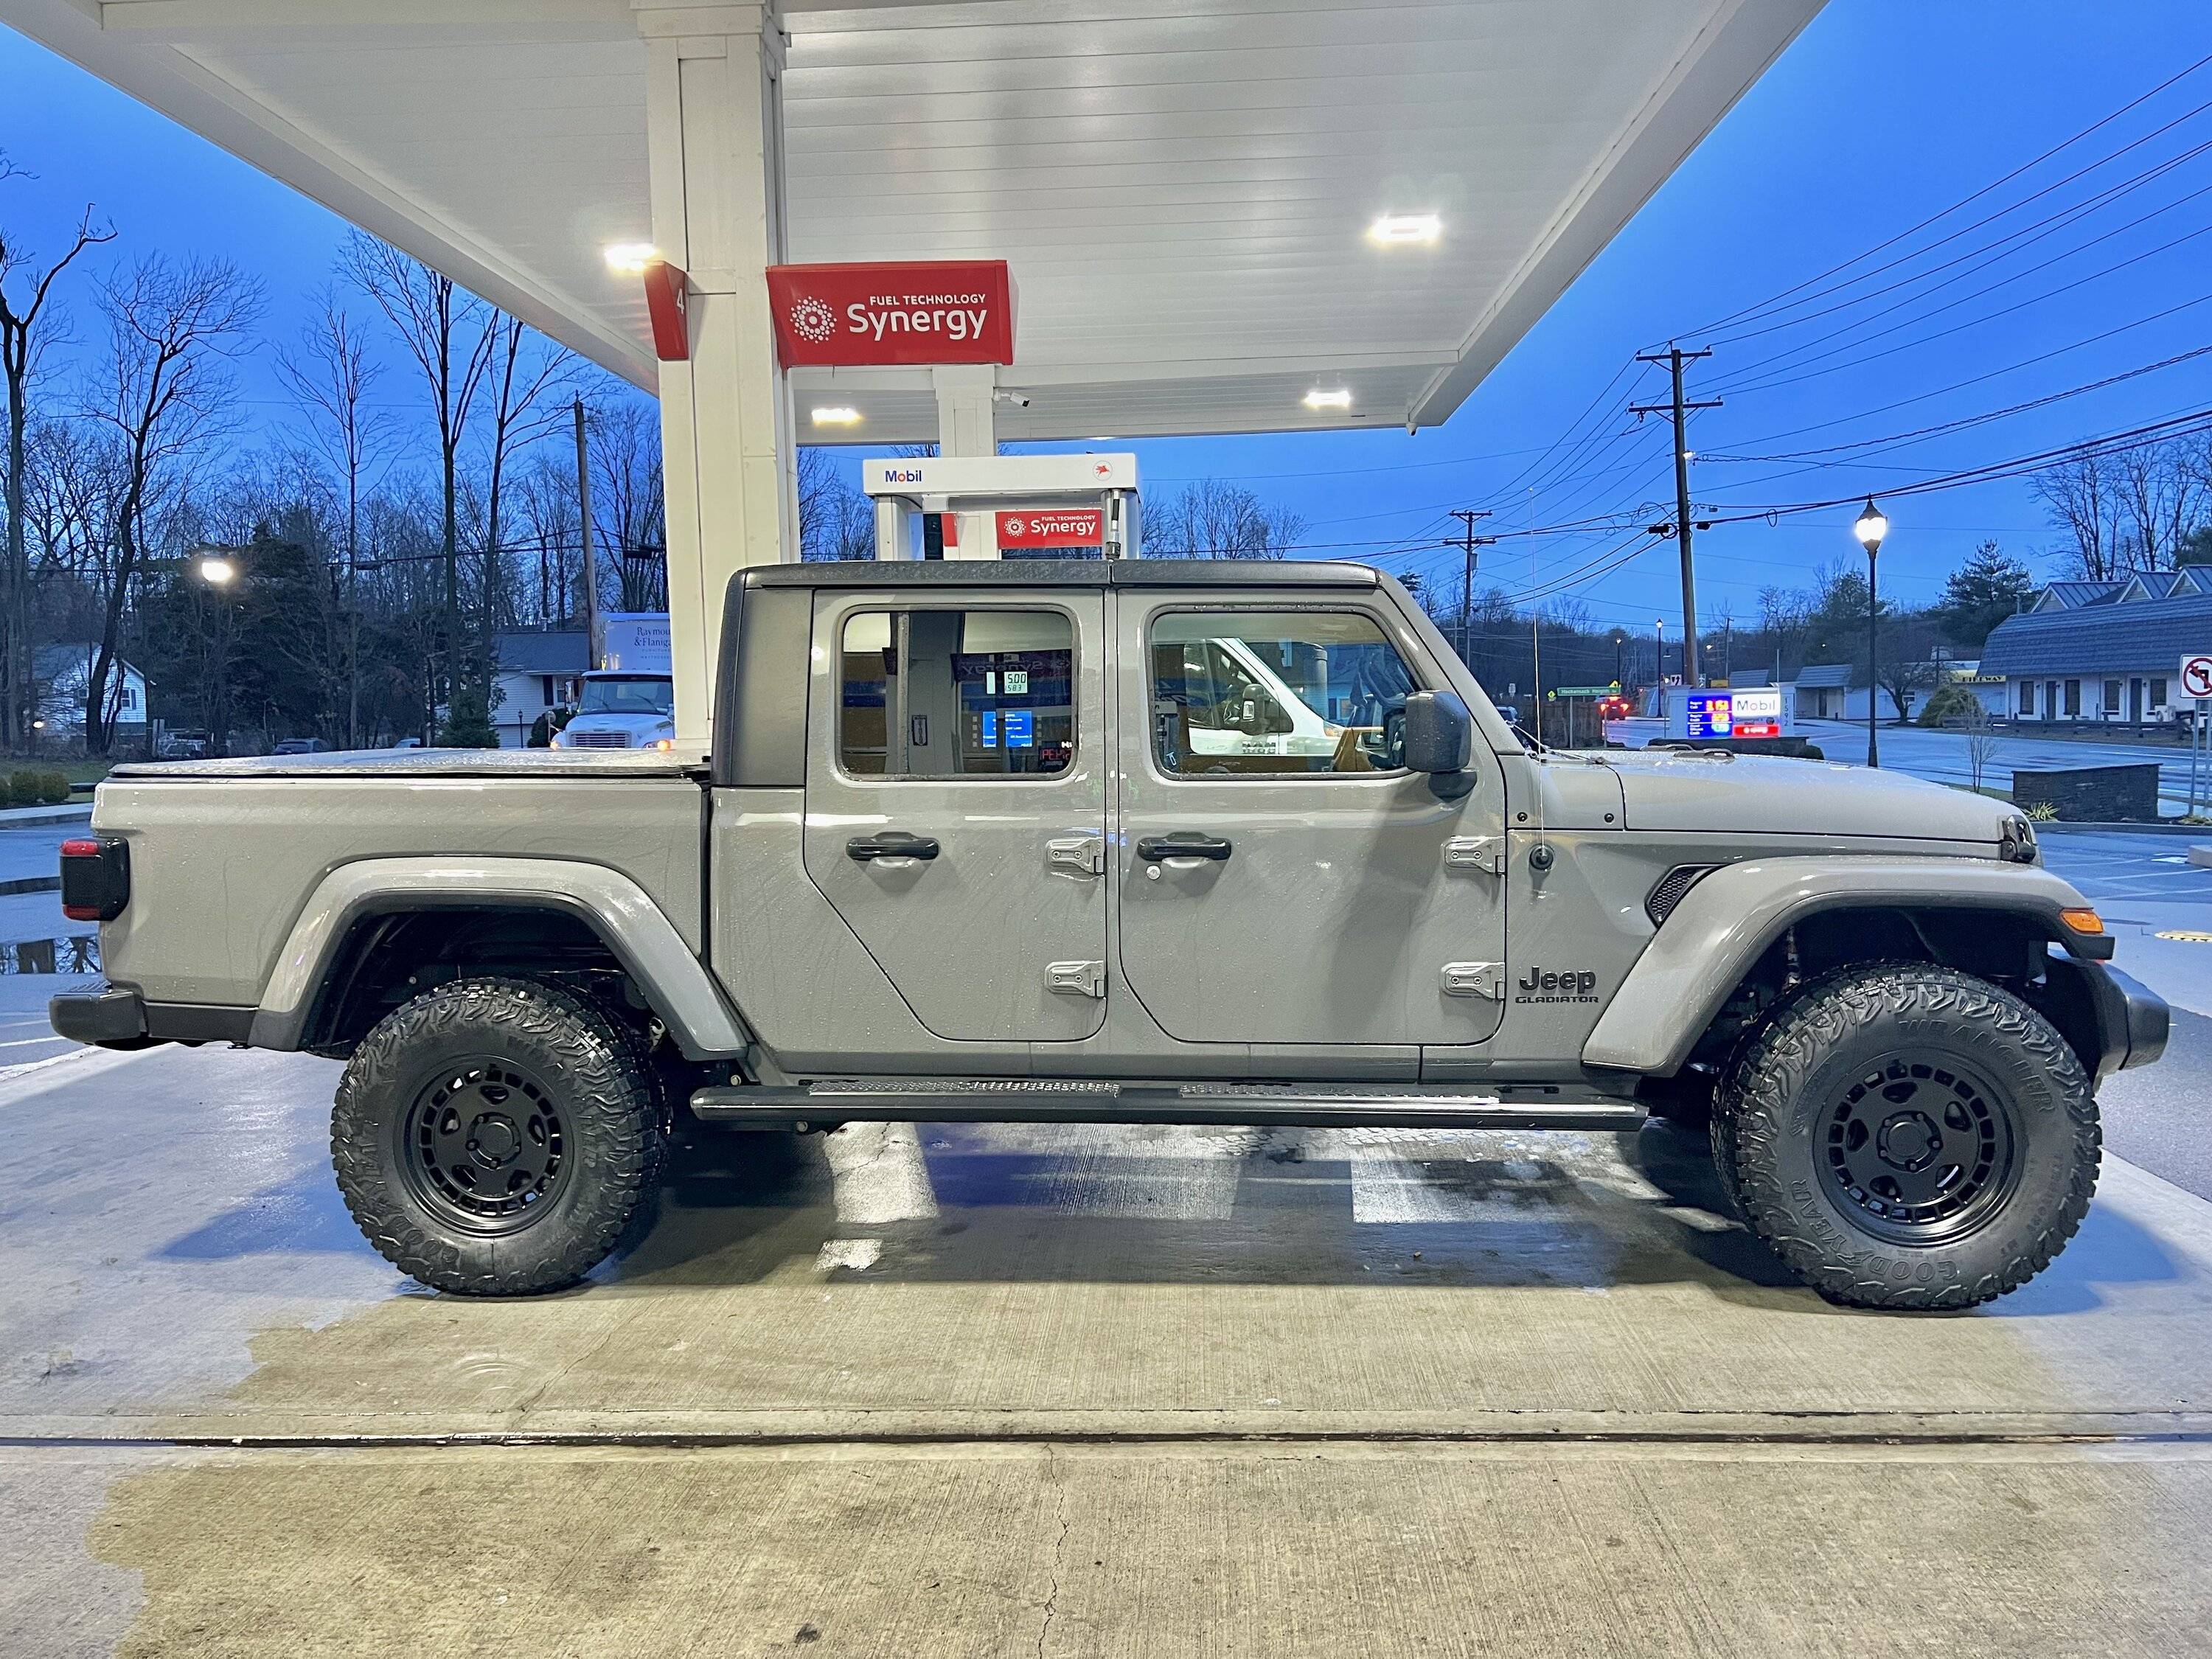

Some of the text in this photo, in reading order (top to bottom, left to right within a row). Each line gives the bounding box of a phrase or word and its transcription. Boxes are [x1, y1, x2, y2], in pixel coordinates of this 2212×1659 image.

[677, 288, 684, 315] 4
[870, 293, 986, 305] FUEL TECHNOLOGY
[847, 303, 987, 341] Synergy
[885, 470, 922, 482] Mobil
[1030, 519, 1096, 536] Synergy
[1737, 700, 1775, 711] Mobil
[1520, 966, 1596, 993] Jeep
[1791, 1179, 1958, 1281] GOODYEAR
